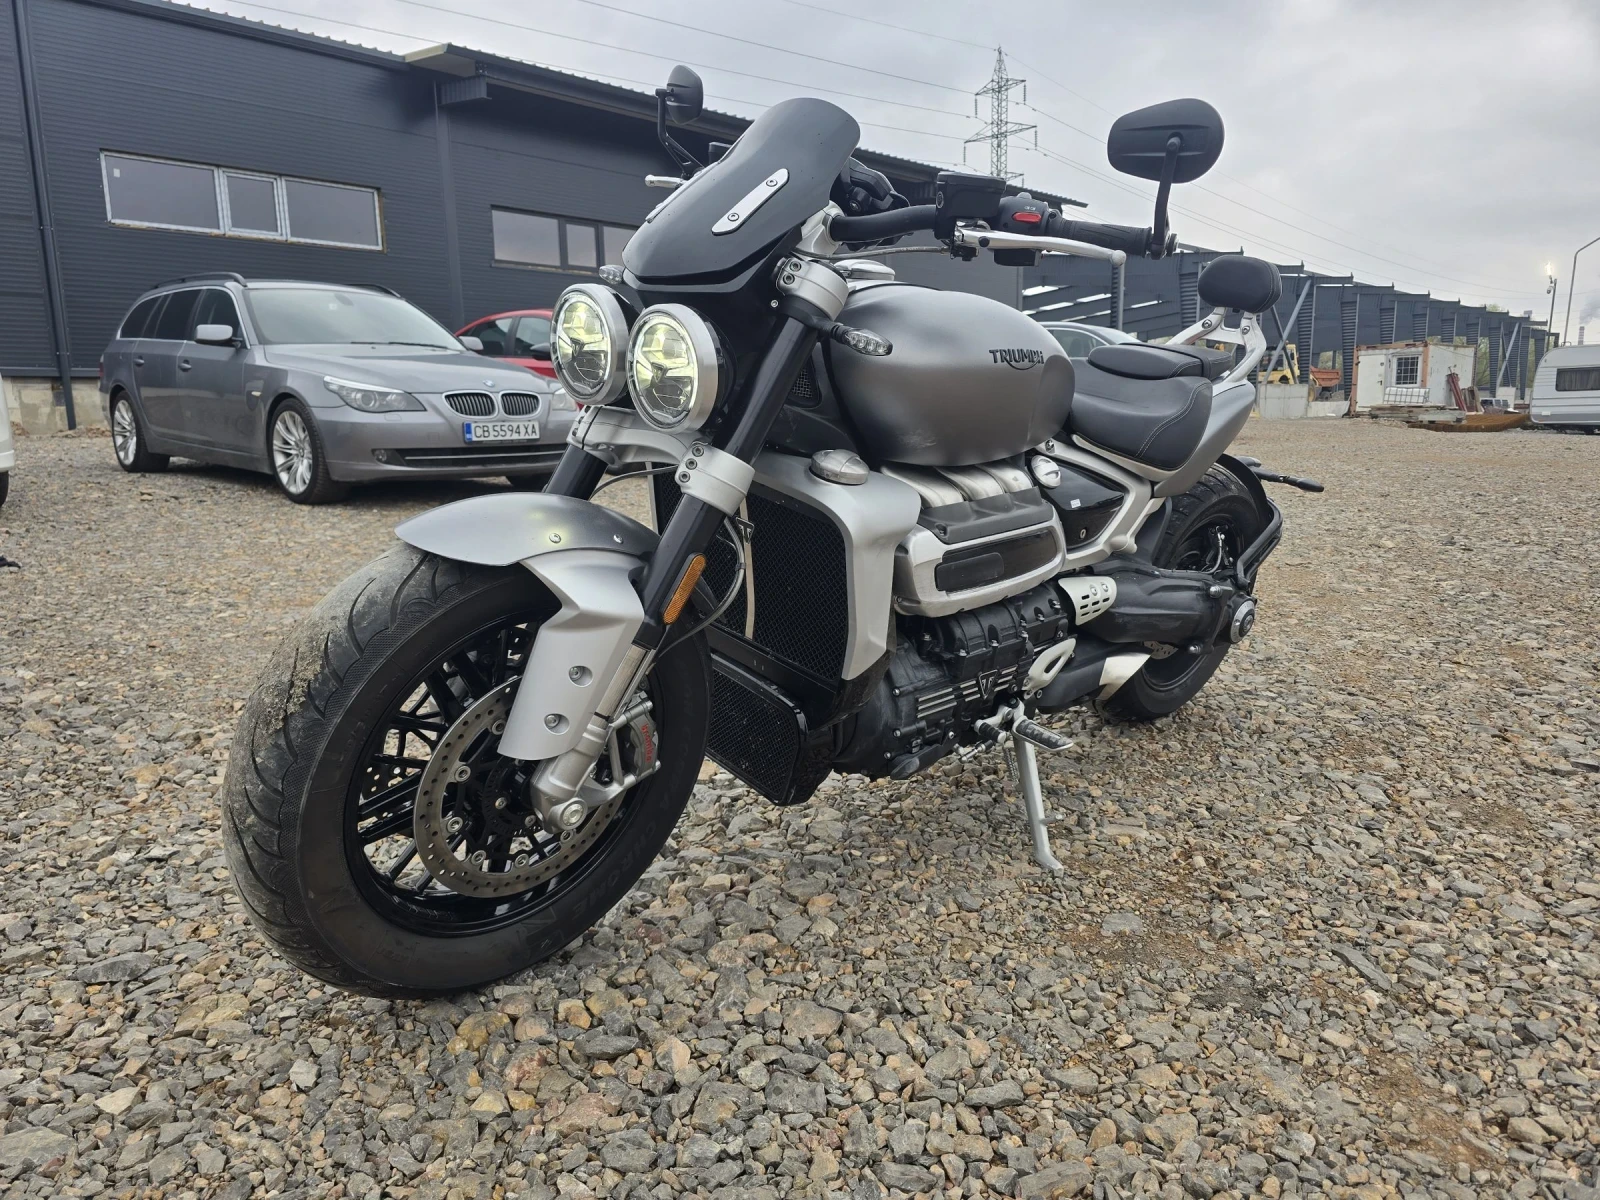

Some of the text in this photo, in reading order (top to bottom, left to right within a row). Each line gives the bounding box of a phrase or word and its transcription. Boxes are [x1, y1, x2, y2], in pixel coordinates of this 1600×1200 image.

[989, 348, 1044, 370] TRIUMPH
[474, 424, 537, 438] CB 5594 XA
